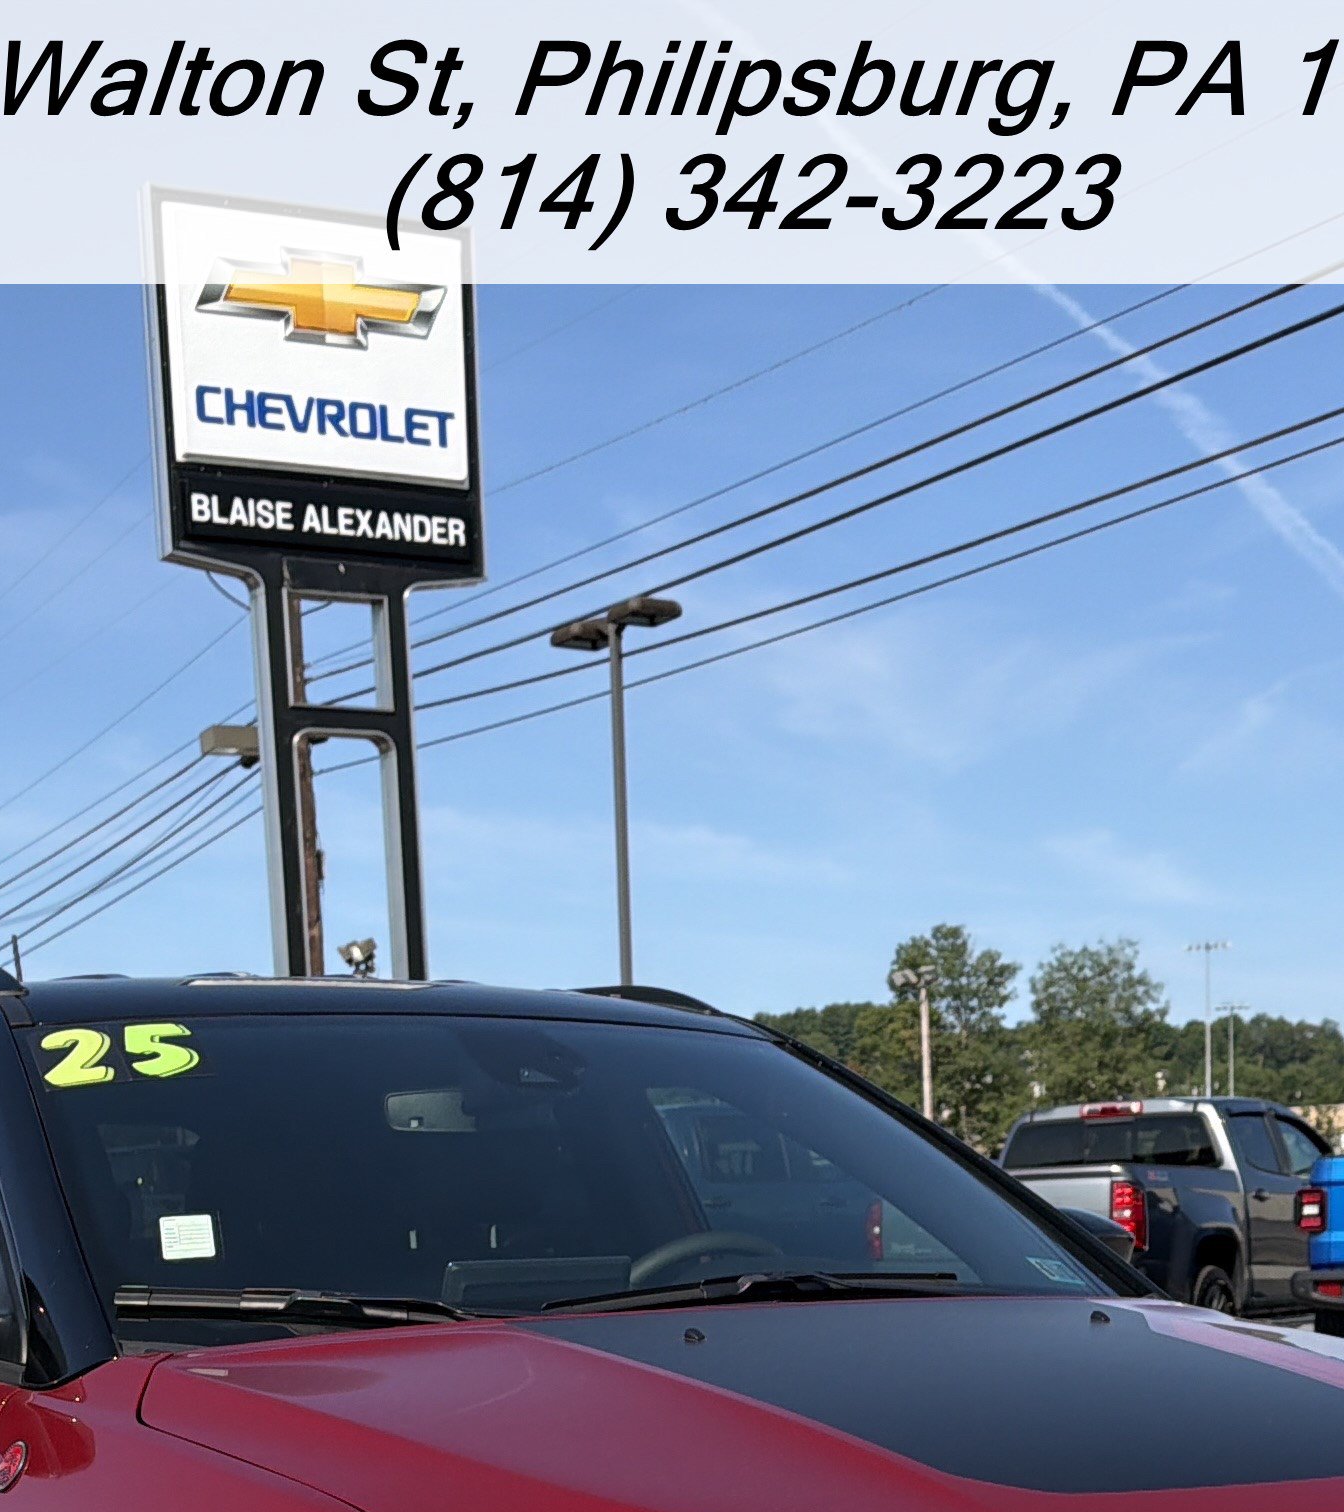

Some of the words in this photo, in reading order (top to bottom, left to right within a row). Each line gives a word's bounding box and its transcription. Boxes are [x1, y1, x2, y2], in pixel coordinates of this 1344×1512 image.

[196, 384, 455, 448] CHEVROLET
[190, 492, 295, 531] BLAISE
[301, 503, 467, 547] ALEXANDER
